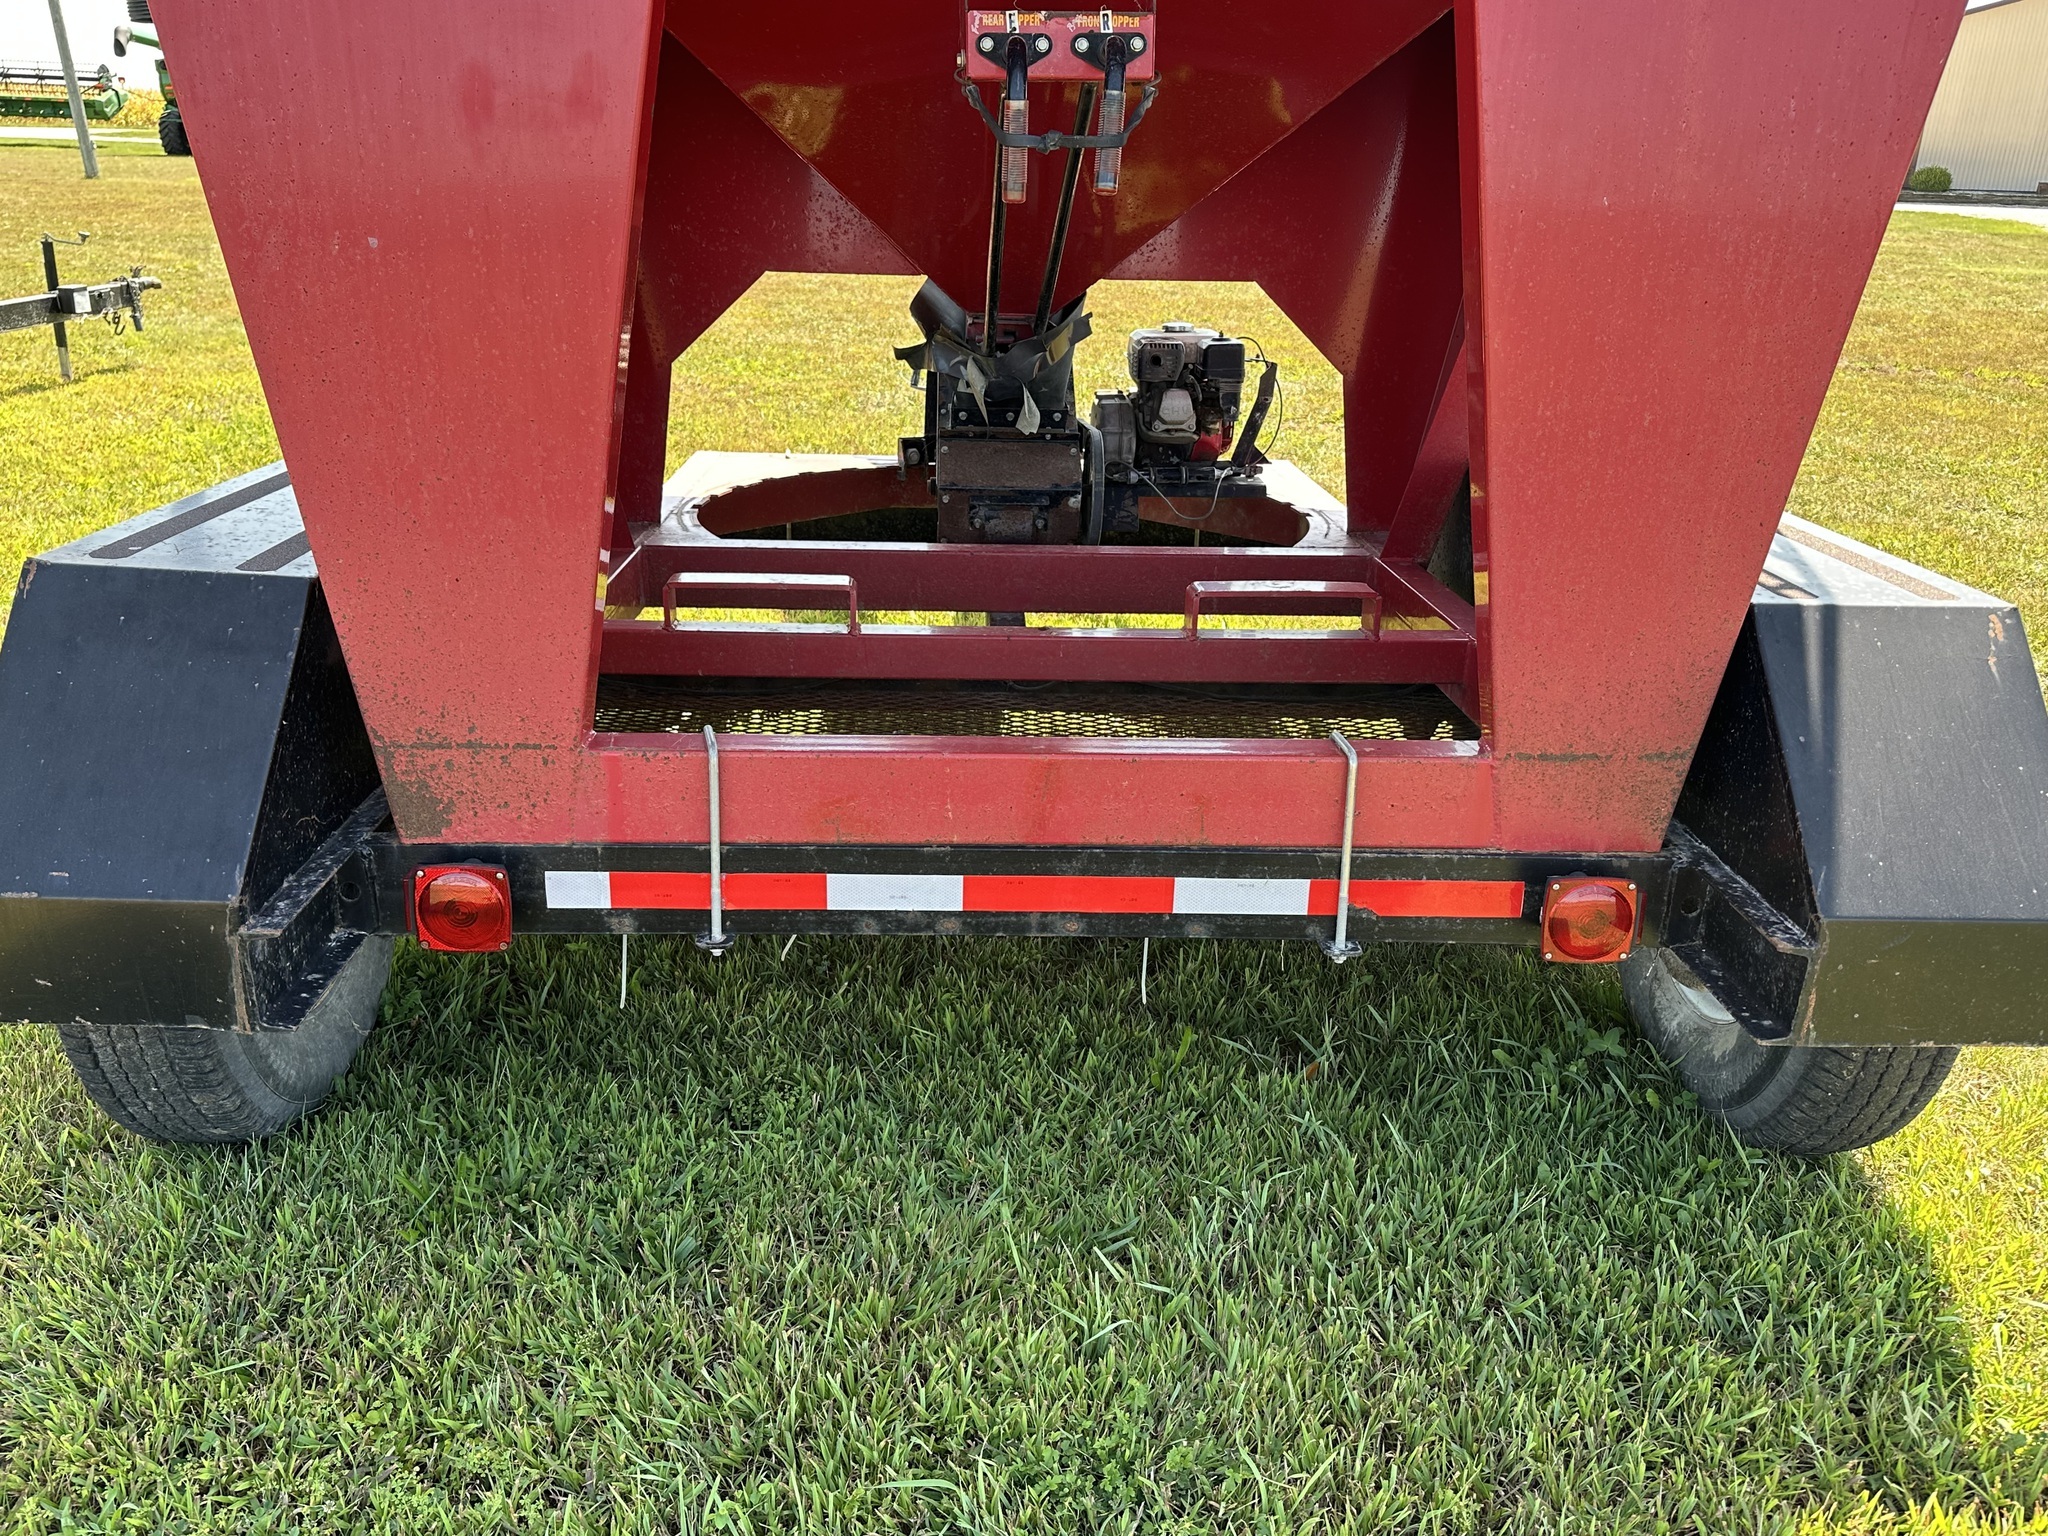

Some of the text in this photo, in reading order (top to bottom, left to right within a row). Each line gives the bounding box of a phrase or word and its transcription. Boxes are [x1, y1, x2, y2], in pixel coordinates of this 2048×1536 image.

[982, 14, 1040, 26] REAR PPER
[1077, 15, 1100, 27] FRON
[1112, 15, 1140, 28] OPPER
[1102, 13, 1110, 31] R
